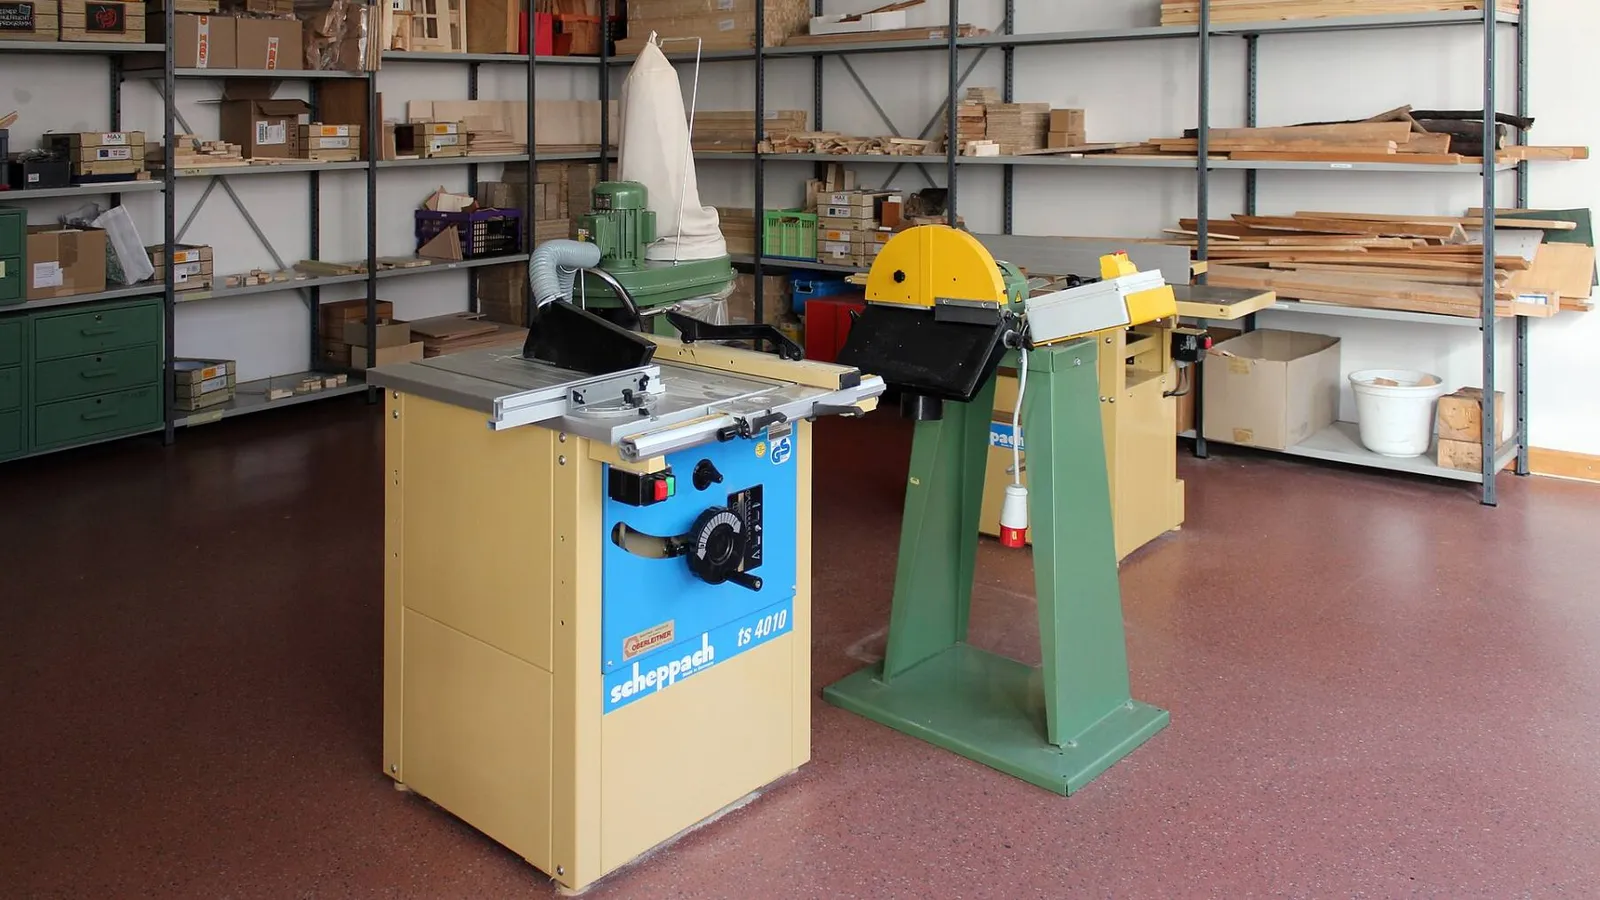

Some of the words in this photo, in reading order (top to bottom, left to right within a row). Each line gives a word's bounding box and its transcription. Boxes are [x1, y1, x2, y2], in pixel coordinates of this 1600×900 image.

[772, 437, 790, 463] GS
[631, 630, 672, 651] OBERLEITNER
[737, 626, 753, 648] ts
[754, 609, 787, 639] 4010
[610, 632, 715, 704] scheppach
